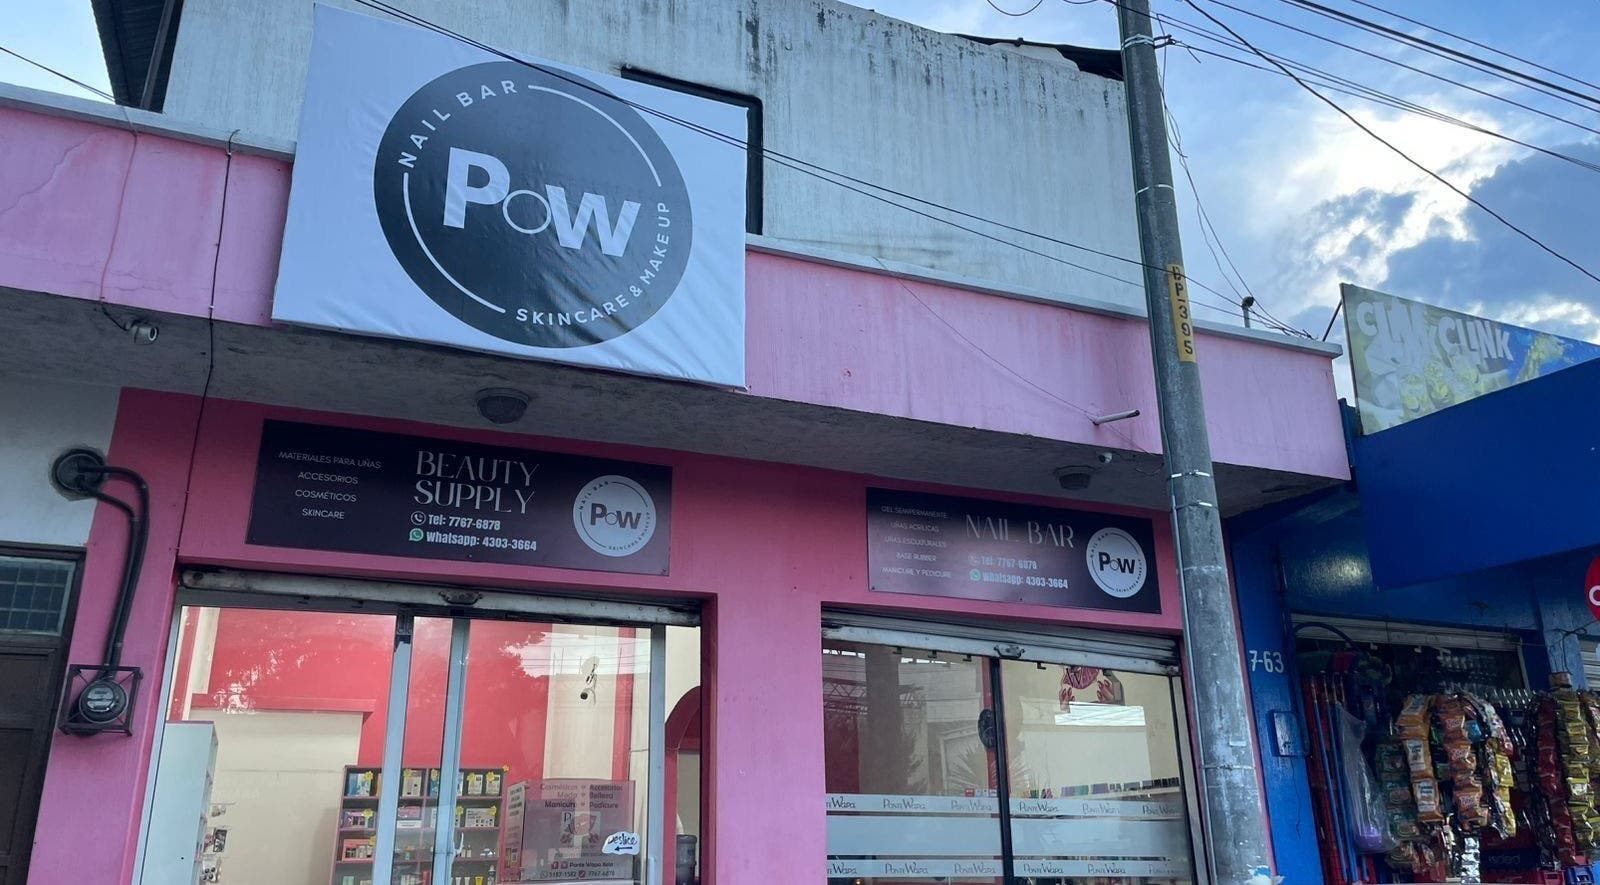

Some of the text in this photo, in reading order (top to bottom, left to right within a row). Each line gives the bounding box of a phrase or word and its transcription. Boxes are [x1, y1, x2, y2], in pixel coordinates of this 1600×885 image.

[398, 79, 518, 168] NAIL BAR
[516, 294, 630, 326] SKINCARE
[630, 285, 643, 298] &
[1437, 315, 1514, 362] CLINK
[278, 451, 382, 469] MATERIALES PARA UÑAS
[416, 450, 540, 487] BEAUTY
[298, 471, 359, 485] ACCESORIOS
[413, 479, 535, 514] SUPPLY
[302, 508, 345, 519] SKINCARE
[428, 514, 501, 531] Tel: 7767-6878
[482, 536, 537, 551] 4303-3664
[965, 514, 1074, 549] NAIL BAR
[1249, 650, 1284, 674] 7-63
